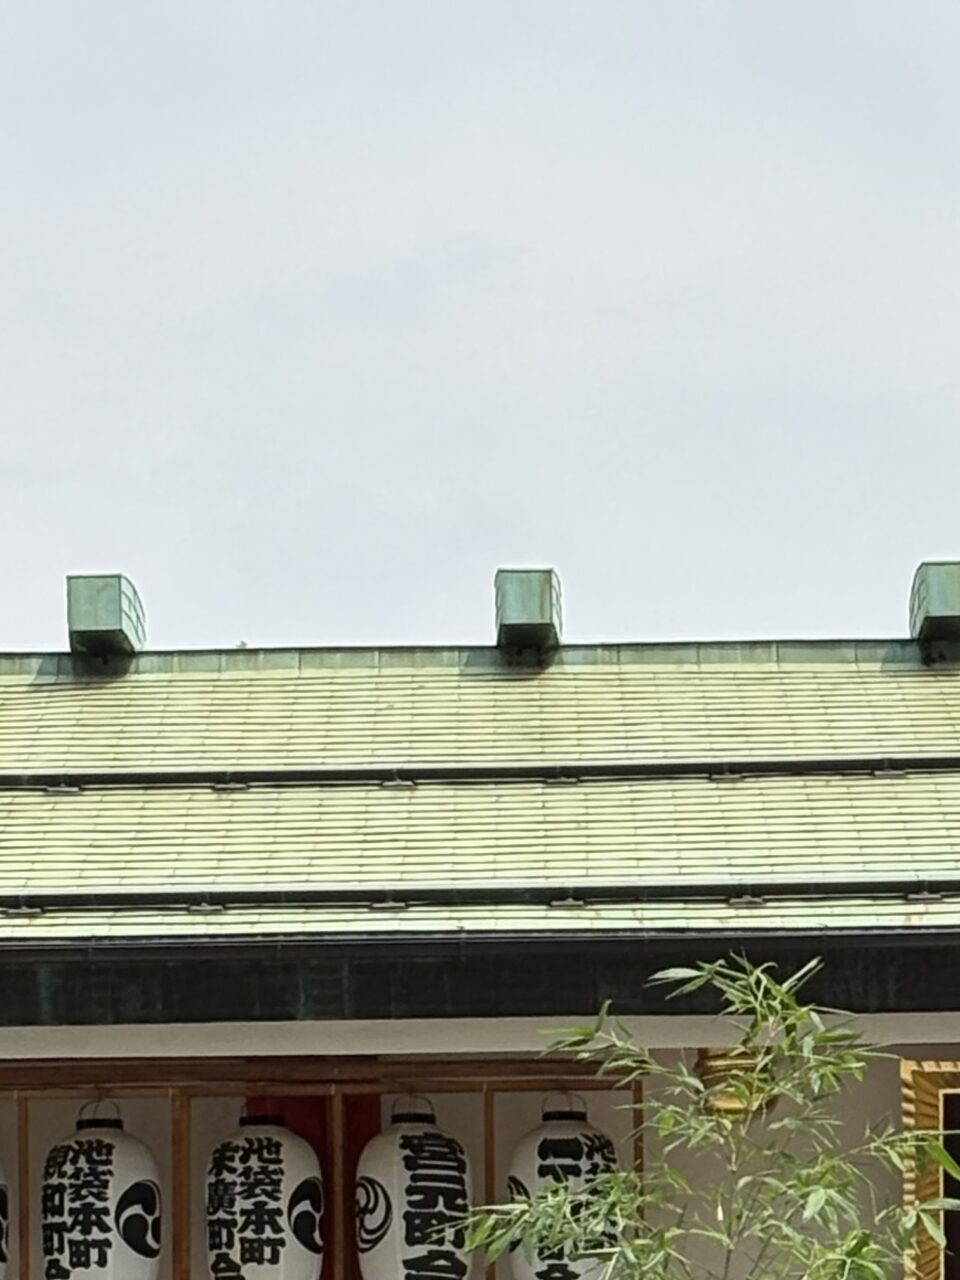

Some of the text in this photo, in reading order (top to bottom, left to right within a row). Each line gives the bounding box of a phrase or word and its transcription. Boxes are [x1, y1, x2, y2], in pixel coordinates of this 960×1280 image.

[68, 1139, 115, 1269] 池袋本町
[237, 1137, 285, 1265] 池袋本町
